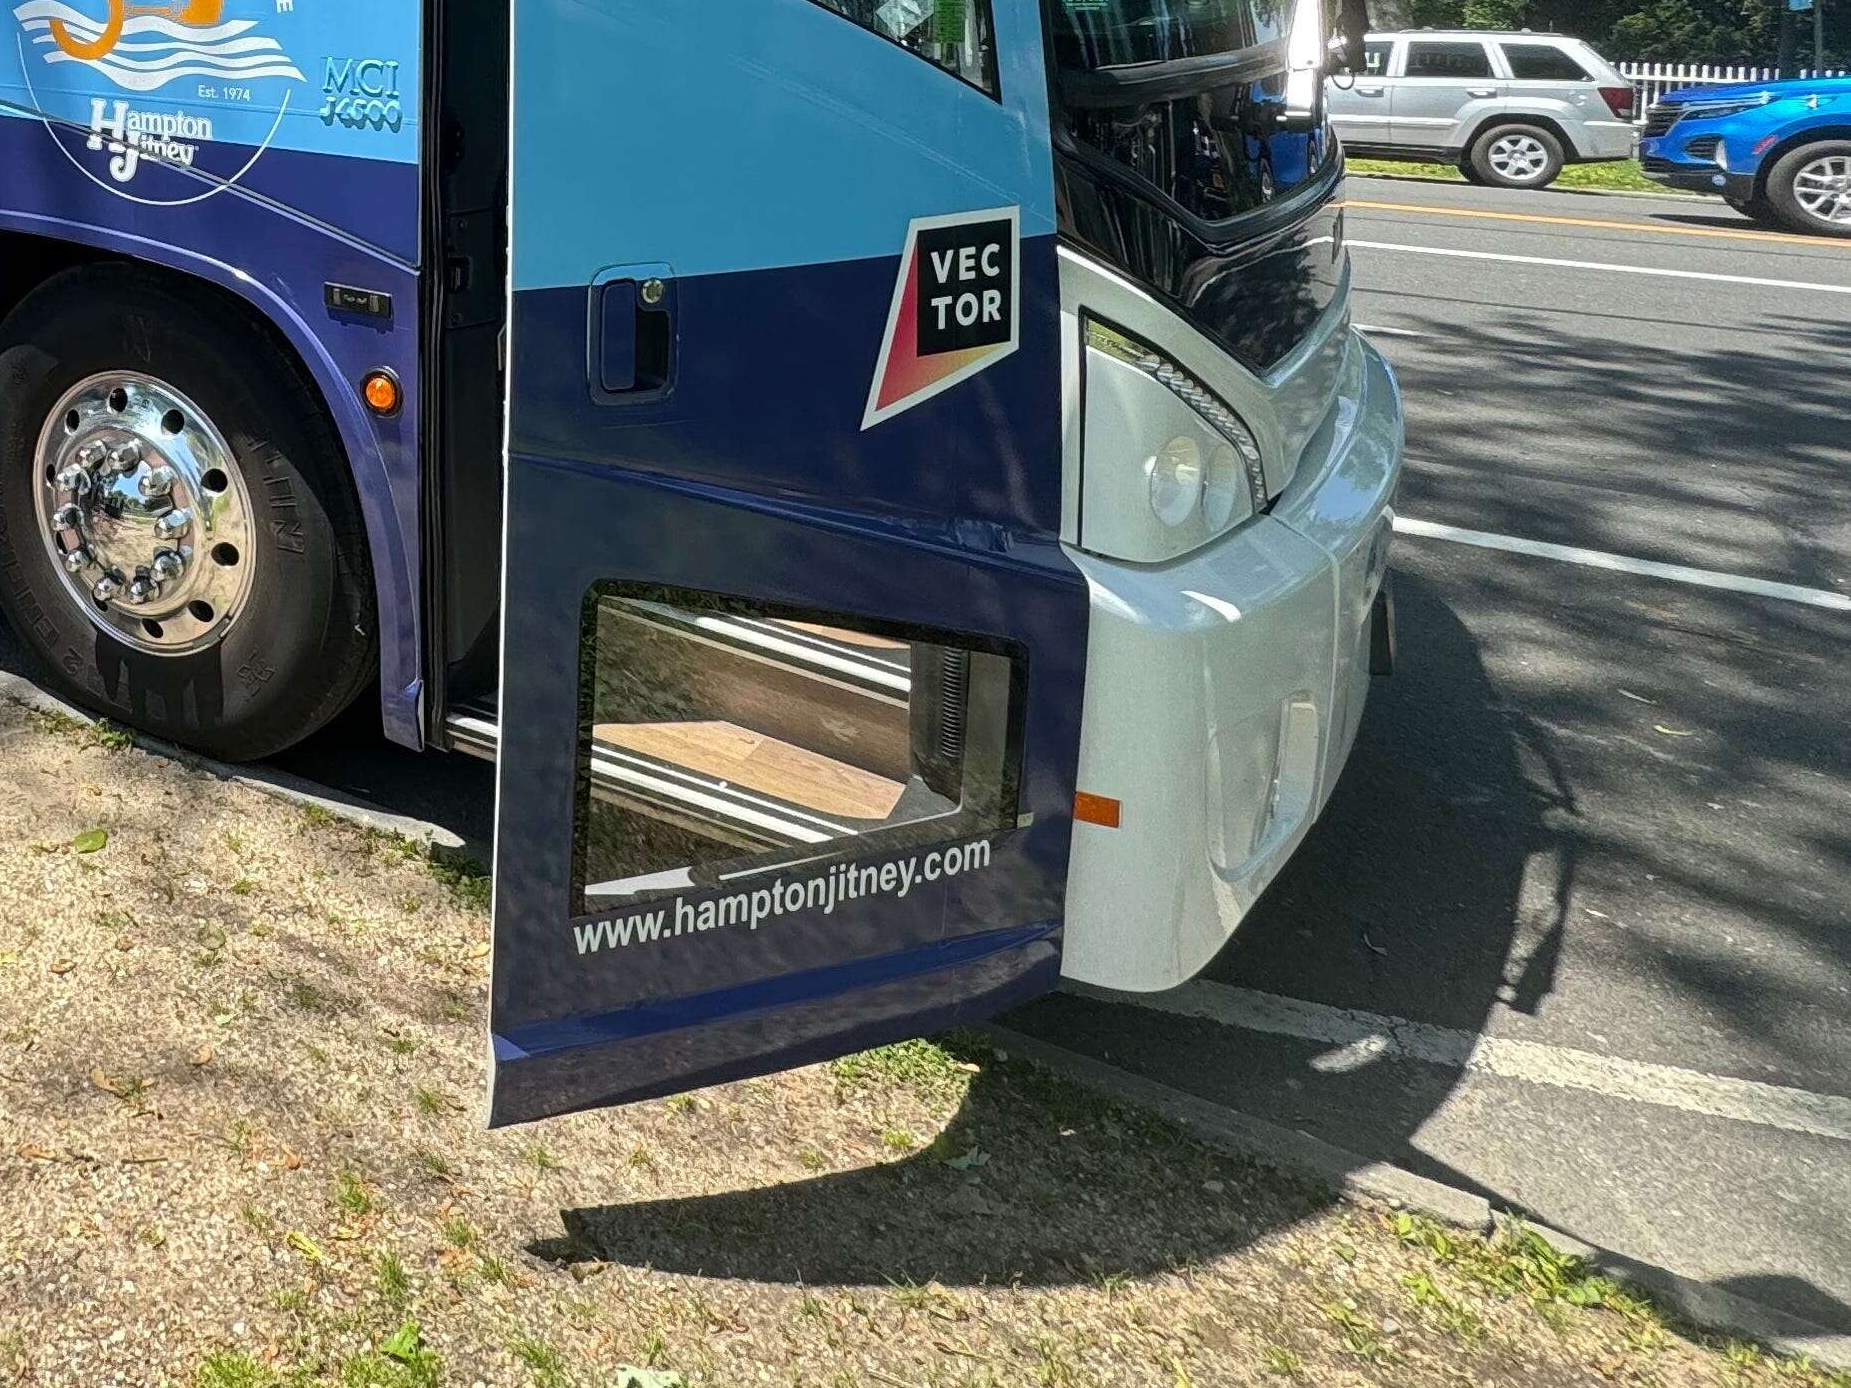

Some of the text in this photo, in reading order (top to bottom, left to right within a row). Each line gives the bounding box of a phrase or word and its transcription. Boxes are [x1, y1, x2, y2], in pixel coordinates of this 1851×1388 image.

[197, 84, 250, 102] Est. 1974
[321, 56, 399, 100] MCI
[86, 97, 213, 154] Hampton
[109, 129, 195, 182] Jitney
[930, 243, 1000, 283] VEC
[930, 289, 1002, 330] TOR
[573, 838, 991, 956] www.hamptonjitney.com
